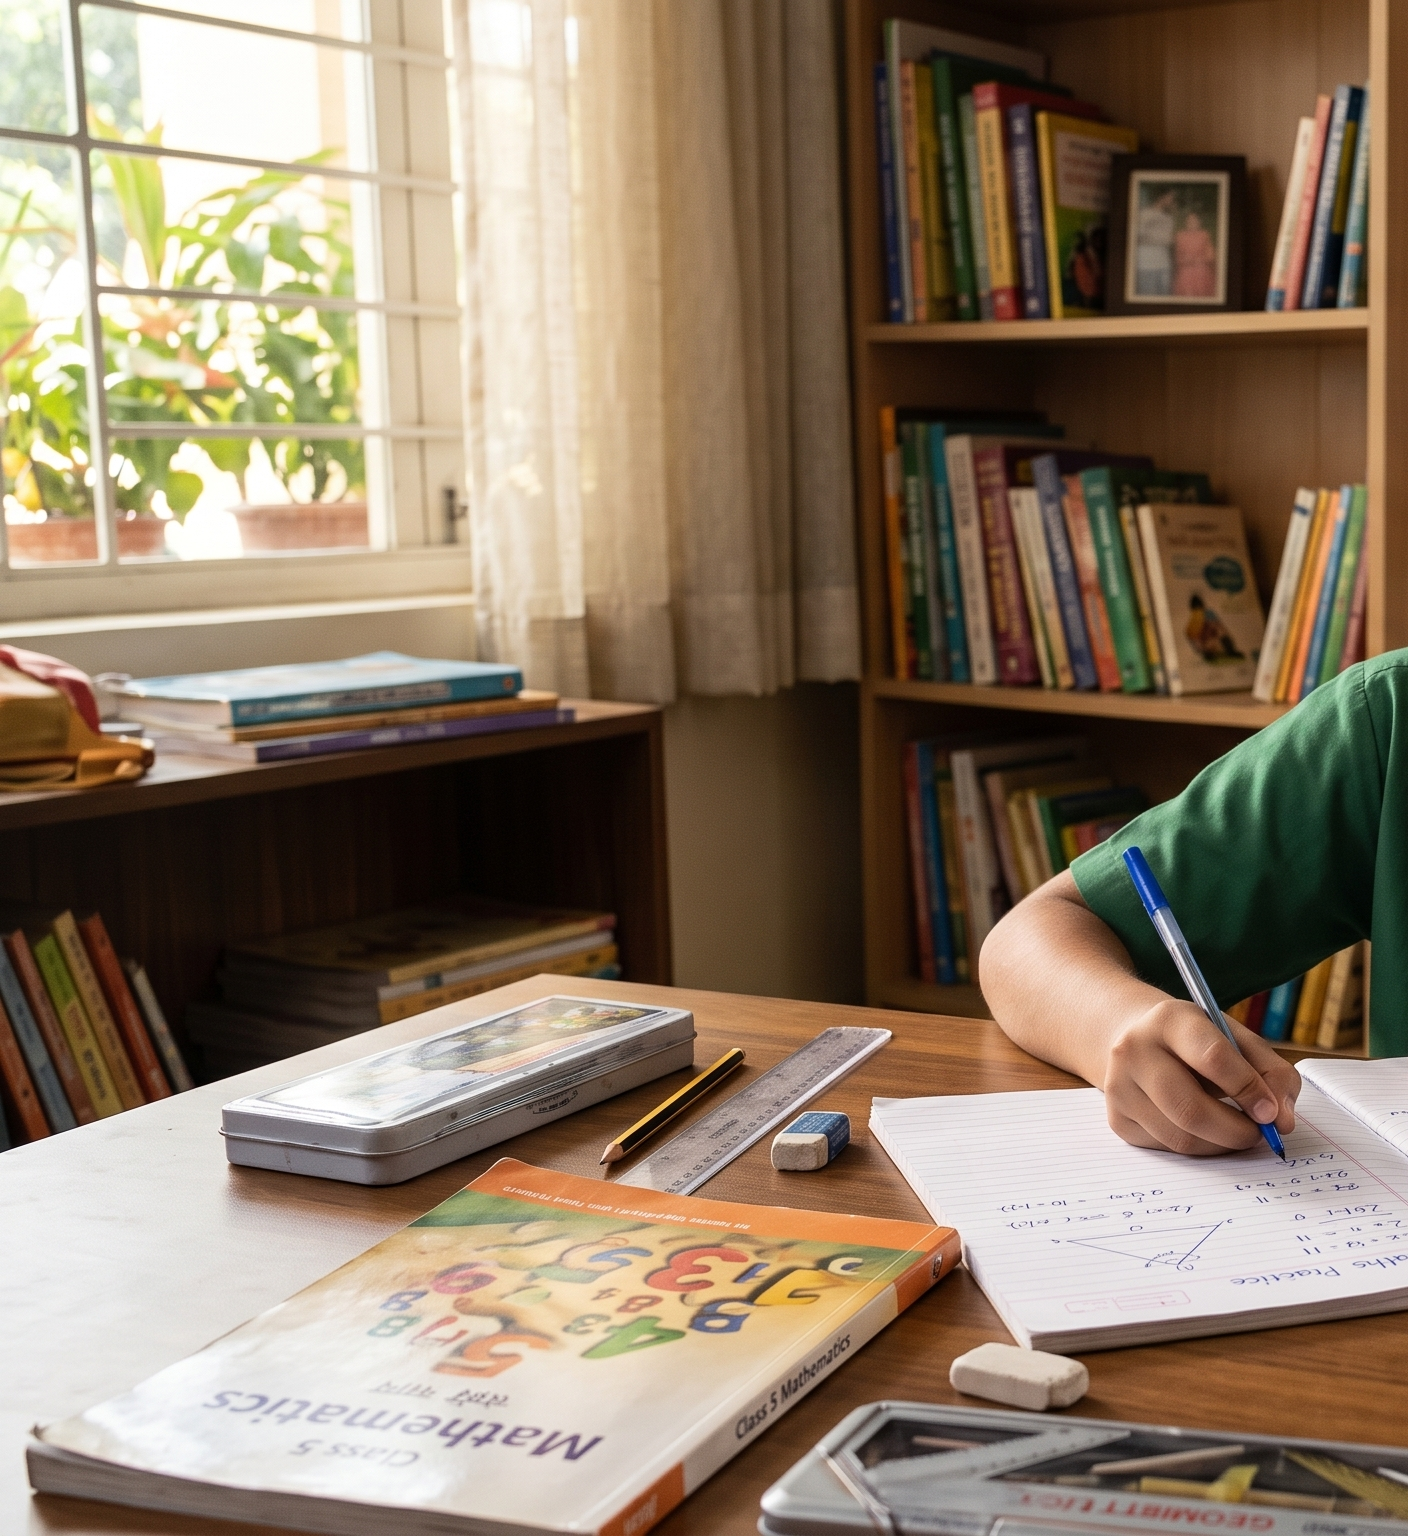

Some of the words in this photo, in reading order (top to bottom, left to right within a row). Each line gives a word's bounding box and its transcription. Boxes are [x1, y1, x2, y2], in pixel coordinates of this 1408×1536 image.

[1230, 1266, 1340, 1286] Practice
[735, 1403, 768, 1439] Class
[770, 1391, 778, 1413] 5
[781, 1334, 851, 1402] Mathematics
[202, 1389, 605, 1461] Mathematics
[288, 1438, 324, 1457] 5
[328, 1441, 420, 1468] Class
